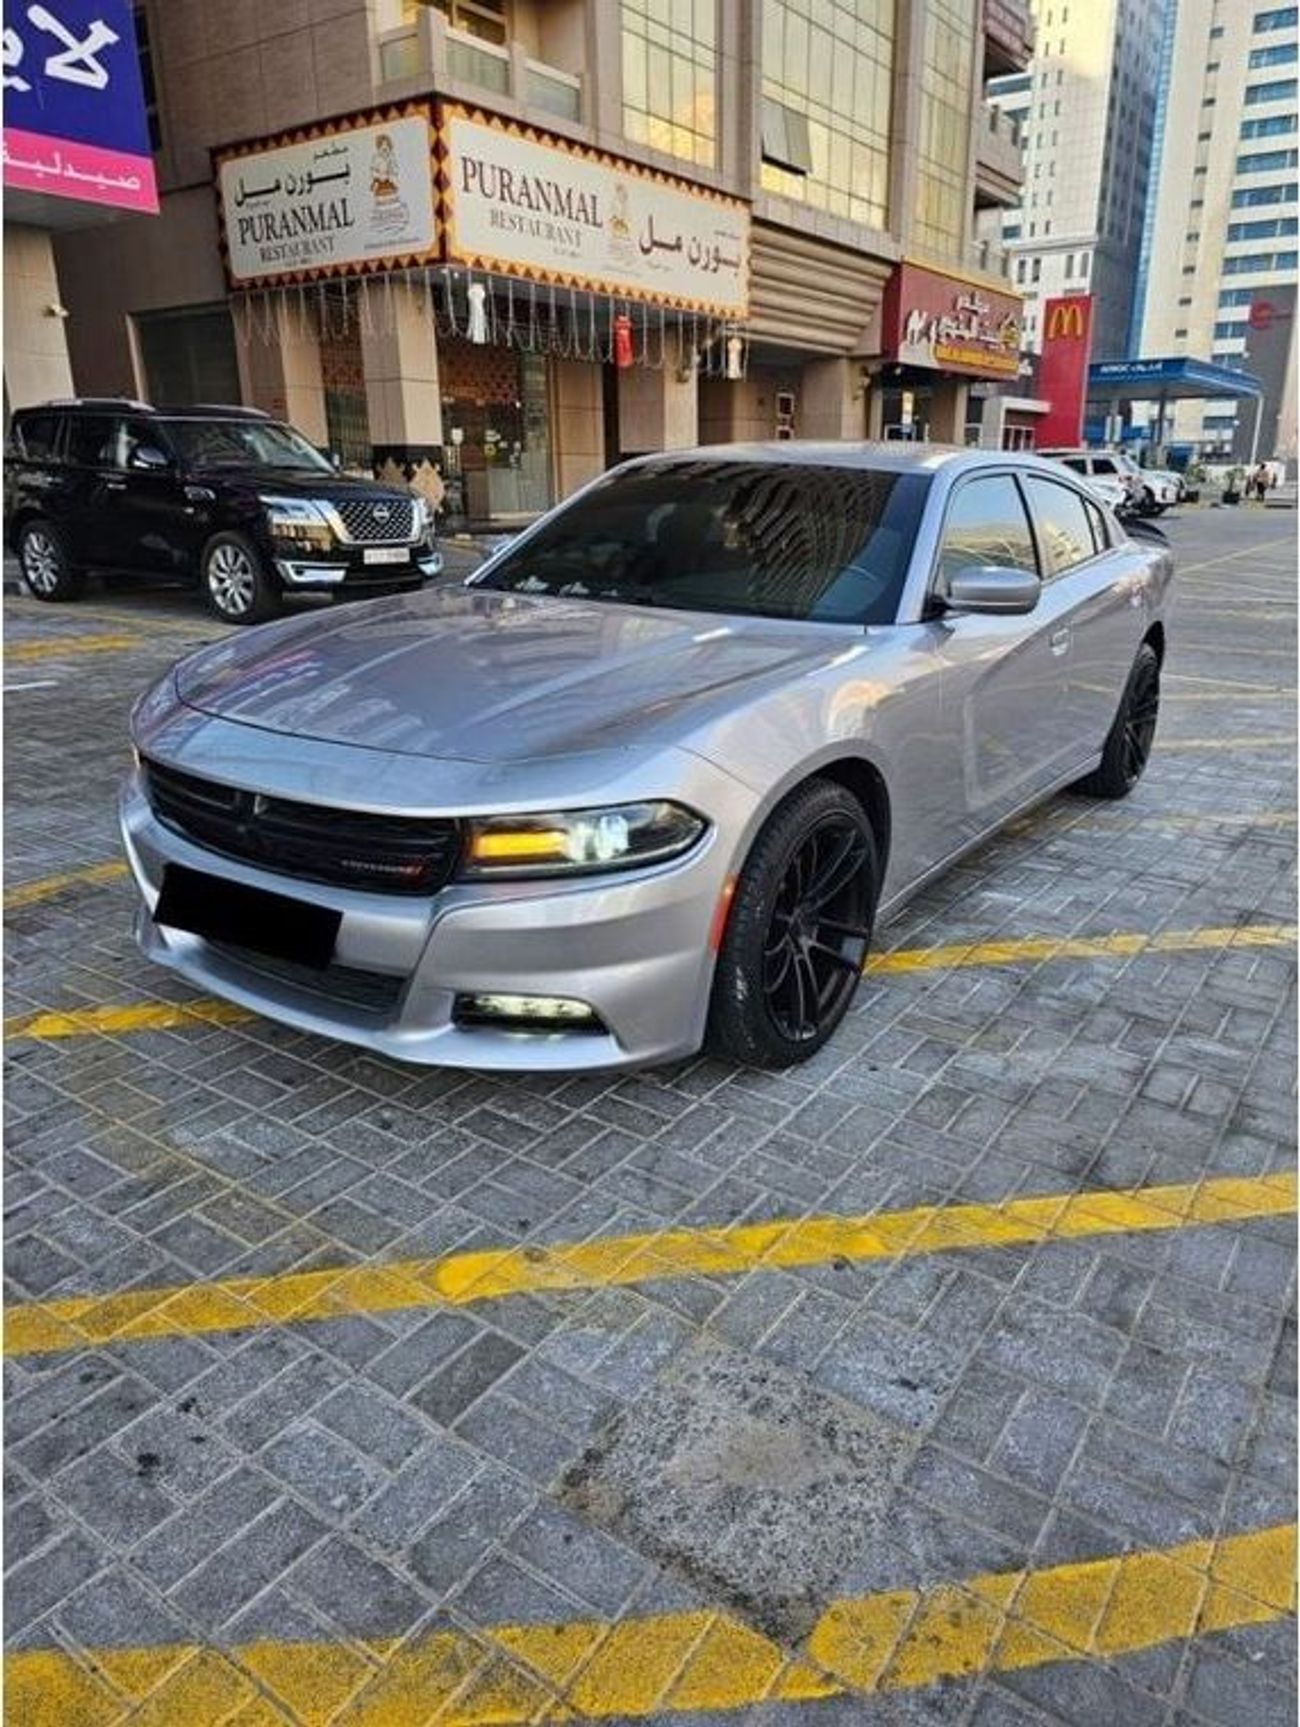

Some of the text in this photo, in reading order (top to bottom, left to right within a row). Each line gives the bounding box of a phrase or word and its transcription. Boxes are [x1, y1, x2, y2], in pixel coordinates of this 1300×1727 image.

[461, 156, 604, 228] PURANMAL
[237, 197, 355, 245] PURANMAL
[490, 209, 582, 247] RESTAURANT
[259, 236, 335, 263] RESTAURANT
